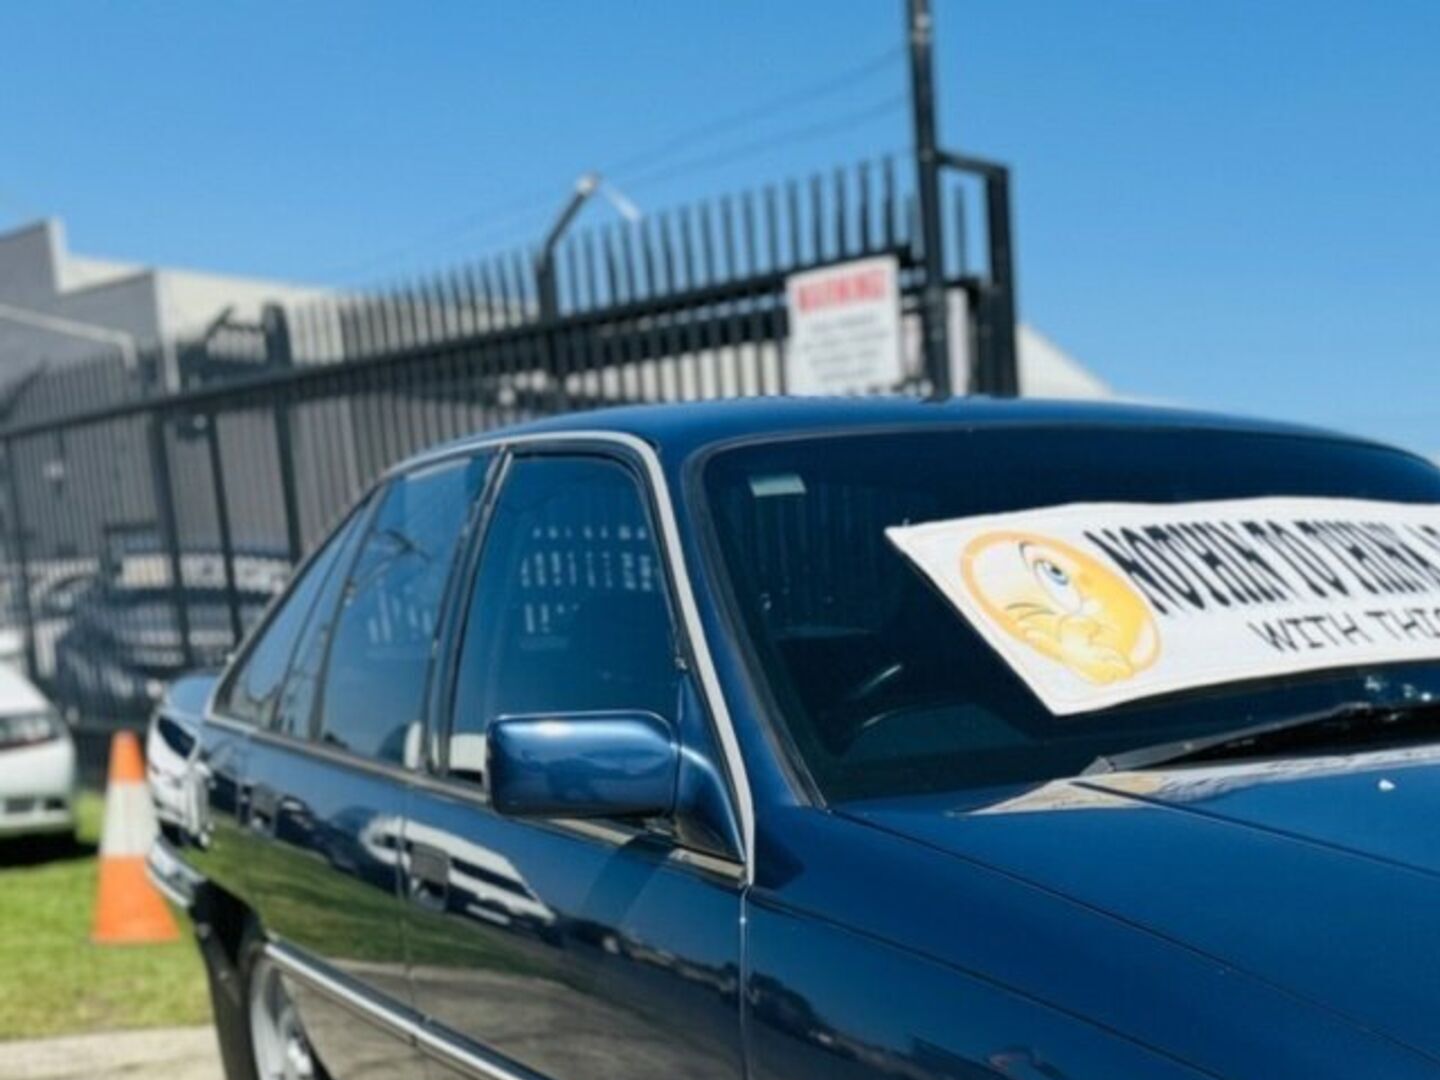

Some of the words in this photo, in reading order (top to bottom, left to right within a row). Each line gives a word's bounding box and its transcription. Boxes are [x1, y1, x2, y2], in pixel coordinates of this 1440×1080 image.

[1083, 520, 1300, 616] NOTHIN
[1237, 520, 1350, 599] TO
[1247, 611, 1373, 652] WITH
